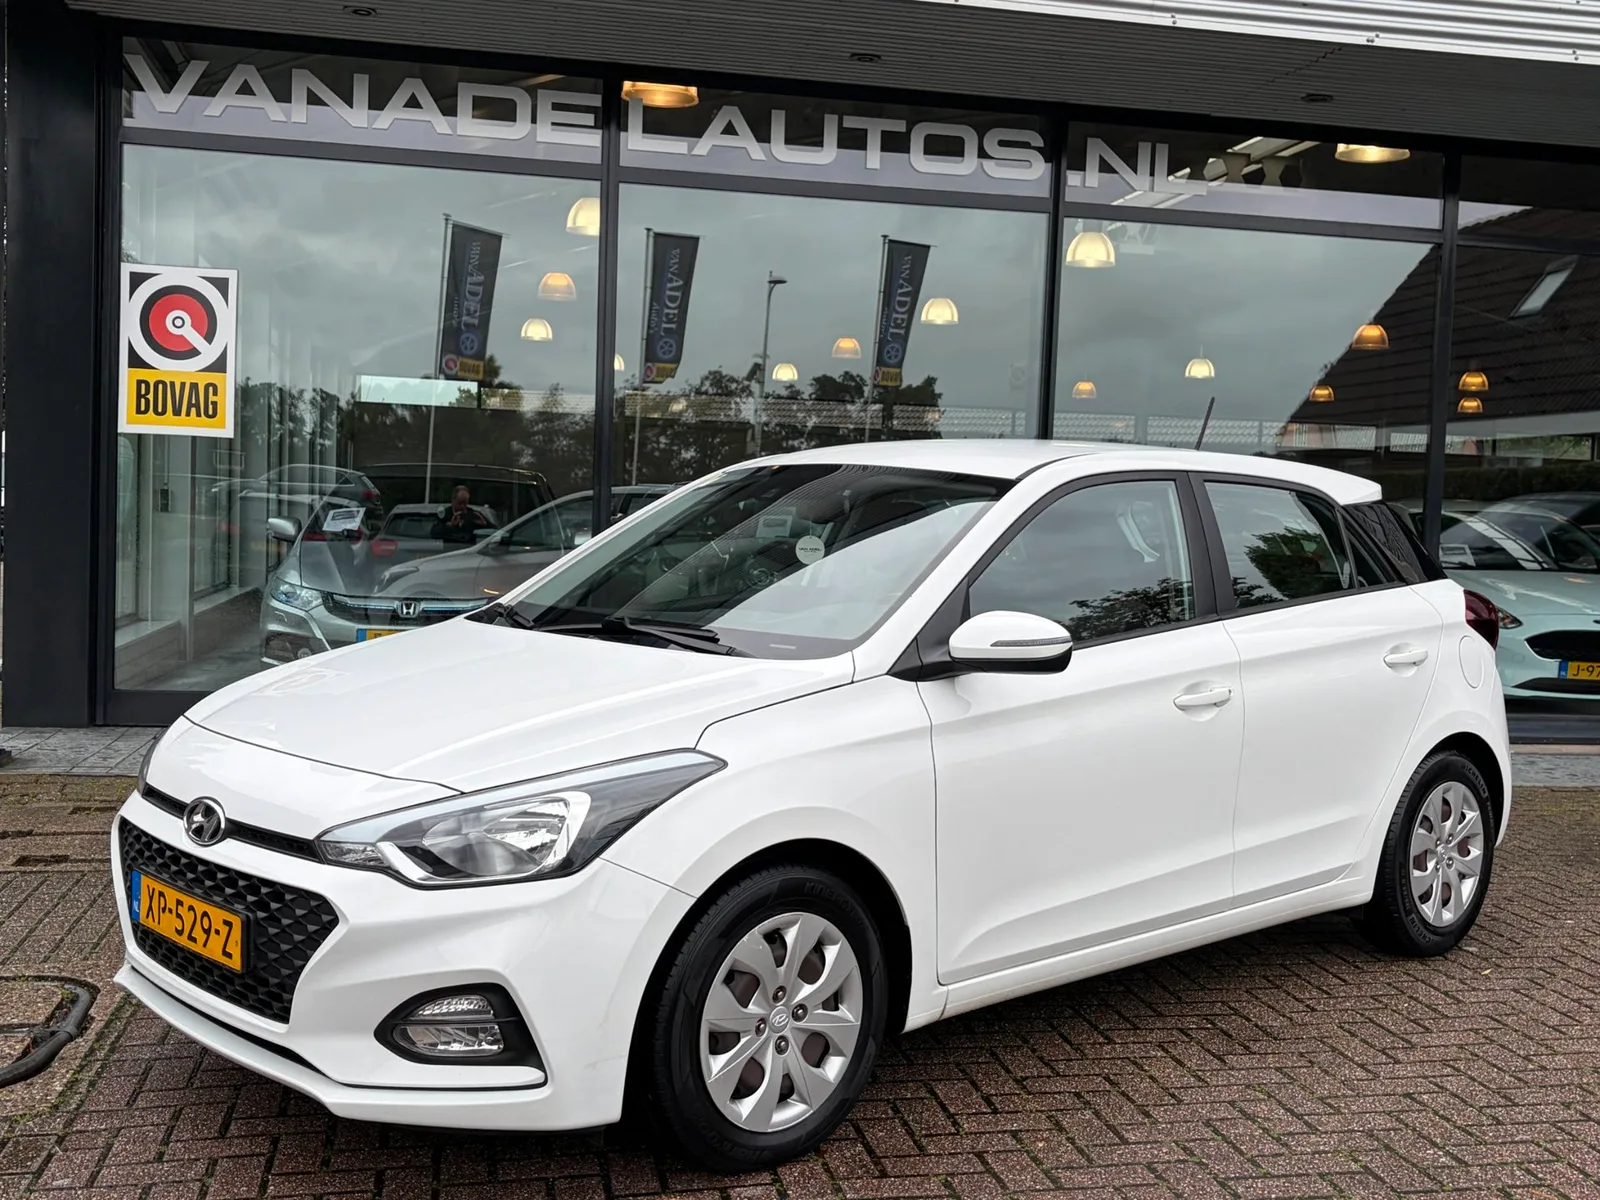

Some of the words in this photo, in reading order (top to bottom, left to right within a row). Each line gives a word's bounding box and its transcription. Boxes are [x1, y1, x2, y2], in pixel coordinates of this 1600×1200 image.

[660, 273, 684, 336] ADEL
[887, 279, 913, 341] ADEL
[135, 379, 219, 419] BOVAG
[145, 884, 234, 961] XP-529-Z
